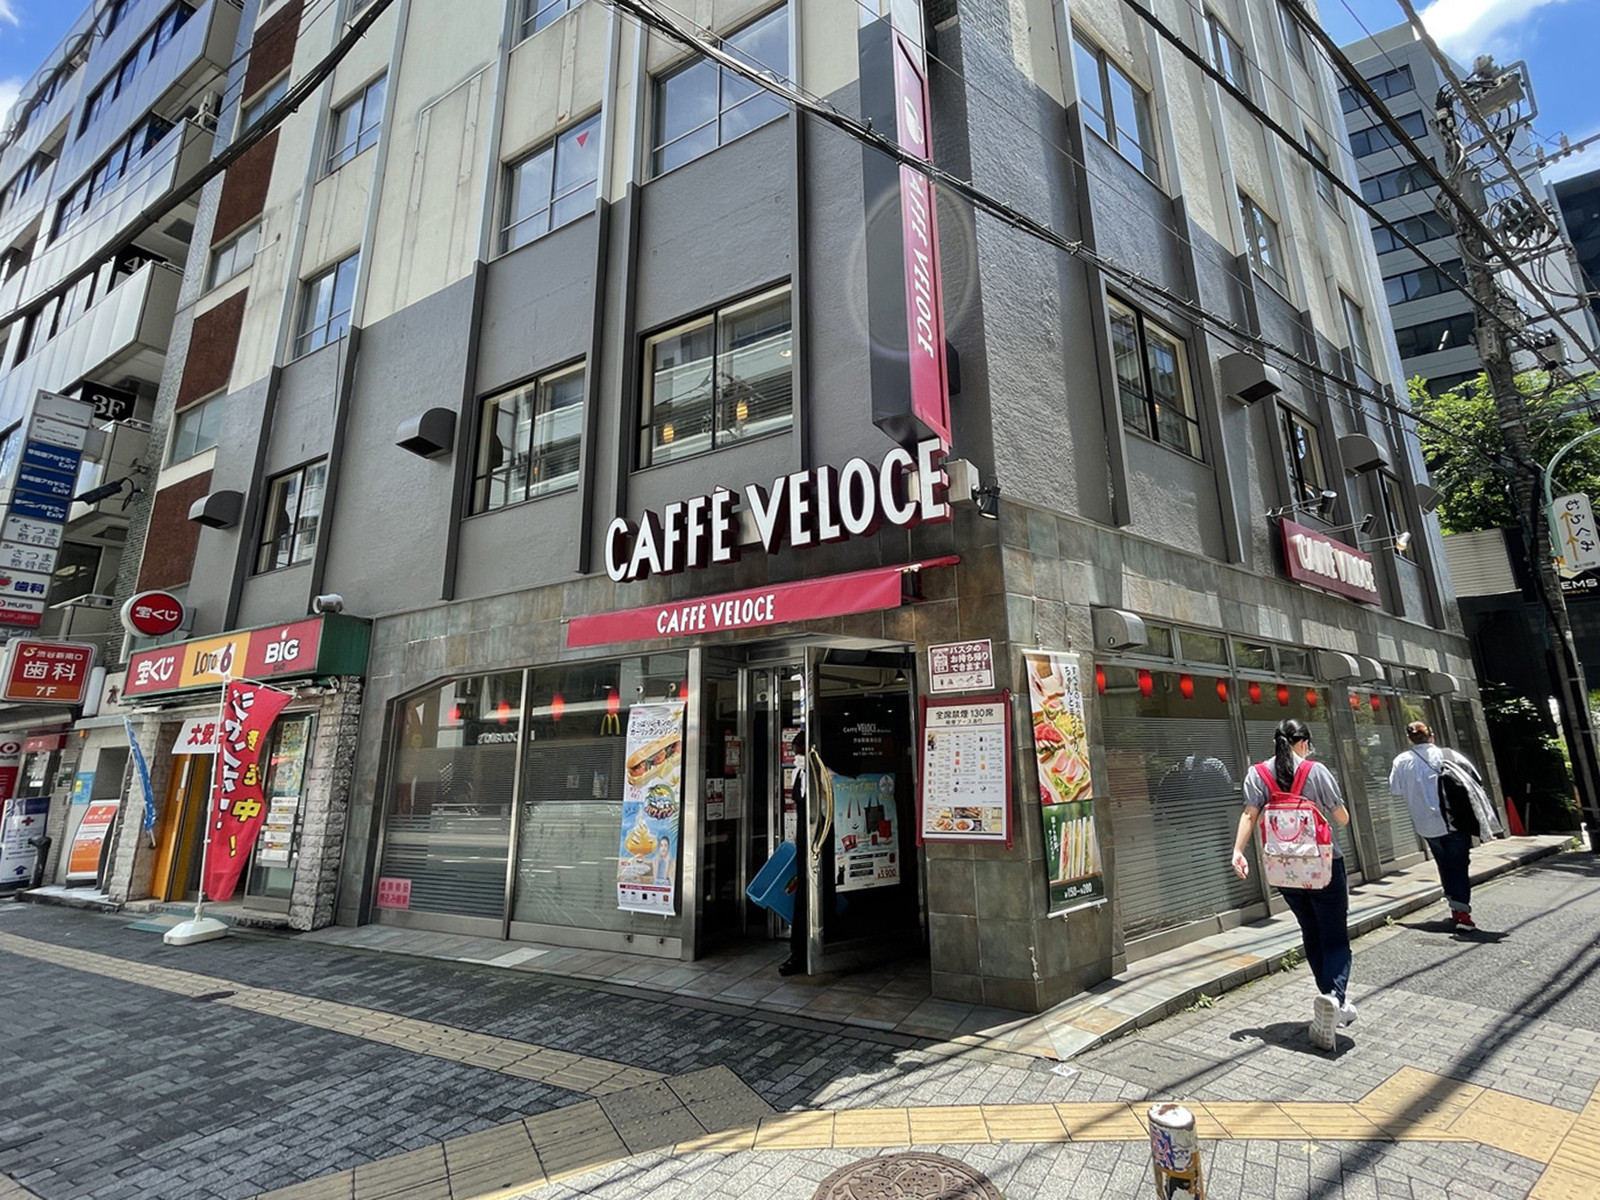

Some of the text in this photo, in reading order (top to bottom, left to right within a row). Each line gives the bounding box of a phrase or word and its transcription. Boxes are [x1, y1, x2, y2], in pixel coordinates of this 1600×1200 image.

[124, 256, 148, 272] 4
[92, 394, 126, 418] 3F
[605, 438, 946, 583] CAFFÈ VELOCE
[19, 523, 60, 537] さつま
[12, 549, 53, 563] さつま
[14, 581, 45, 594] 歯科
[1561, 578, 1598, 590] EMS
[135, 605, 179, 622] 宝くじ
[711, 594, 775, 628] VELOCE
[264, 638, 300, 664] BIG
[950, 644, 982, 654] パスタの
[950, 652, 989, 664] お持ち帰り
[23, 660, 77, 681] 歯科
[135, 656, 175, 686] 宝くじ
[35, 685, 58, 697] 7F
[936, 709, 968, 720] 全席禁煙
